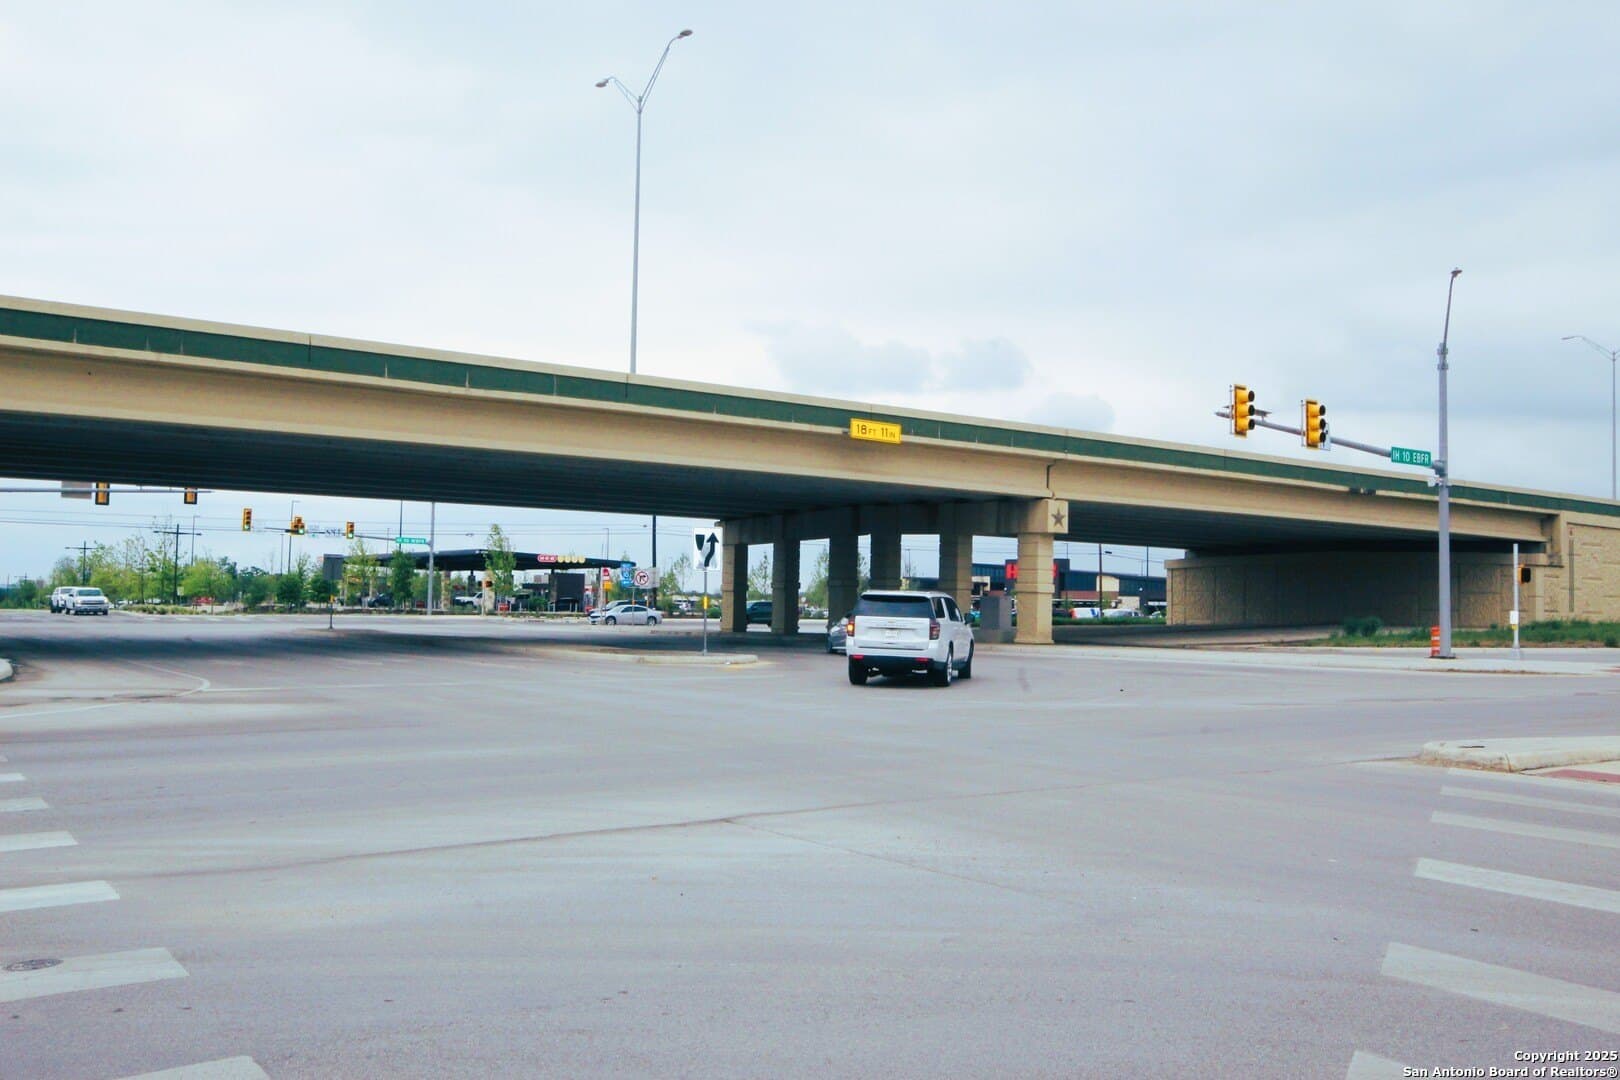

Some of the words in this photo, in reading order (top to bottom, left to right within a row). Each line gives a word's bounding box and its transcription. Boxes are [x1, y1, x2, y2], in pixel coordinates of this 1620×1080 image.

[856, 423, 868, 435] 18
[1392, 449, 1400, 462] IH
[1402, 451, 1411, 463] 10
